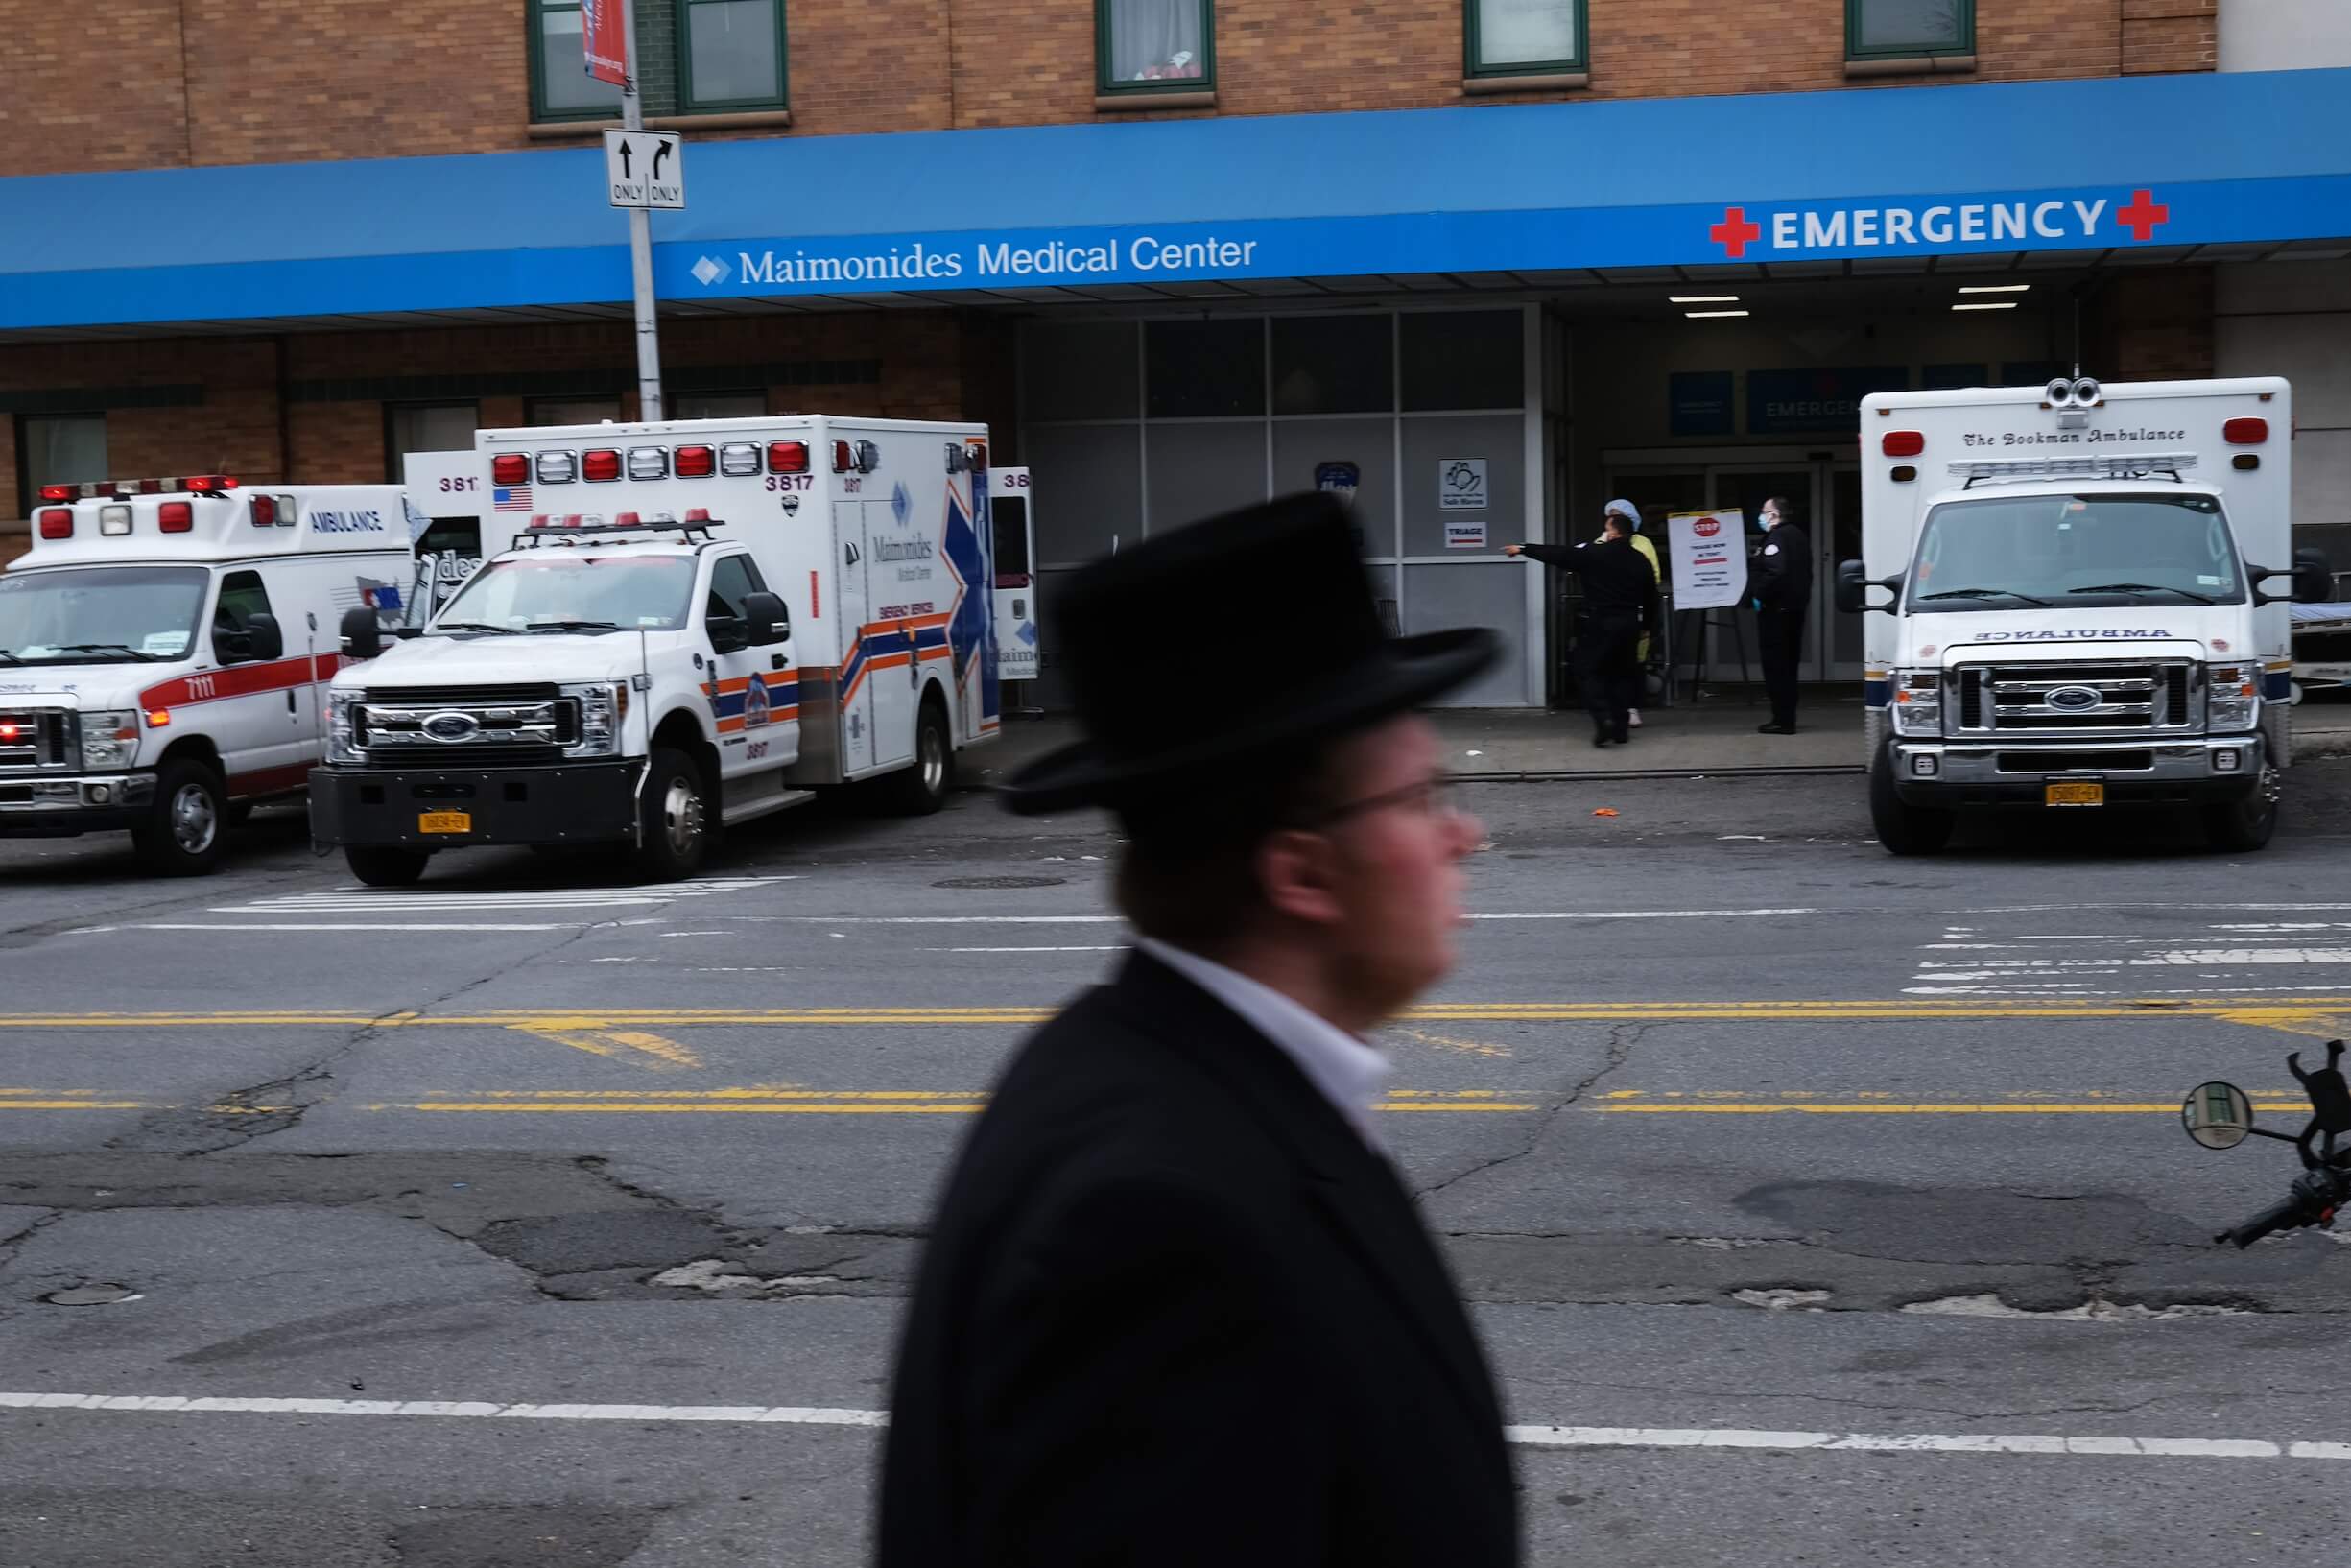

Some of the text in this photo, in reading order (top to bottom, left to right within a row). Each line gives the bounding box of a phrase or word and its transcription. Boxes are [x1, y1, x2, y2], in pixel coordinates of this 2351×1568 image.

[614, 185, 643, 200] ONLY
[652, 186, 680, 201] ONLY
[1772, 199, 2107, 249] EMERGENCY
[739, 237, 1256, 284] Maimonides Medical Center
[1963, 429, 2185, 446] The Bookman Ambulance
[439, 476, 479, 492] 381
[765, 475, 814, 491] 3817
[309, 510, 385, 534] AMBULANCE
[1695, 523, 1719, 532] STOP
[185, 675, 216, 699] 7111
